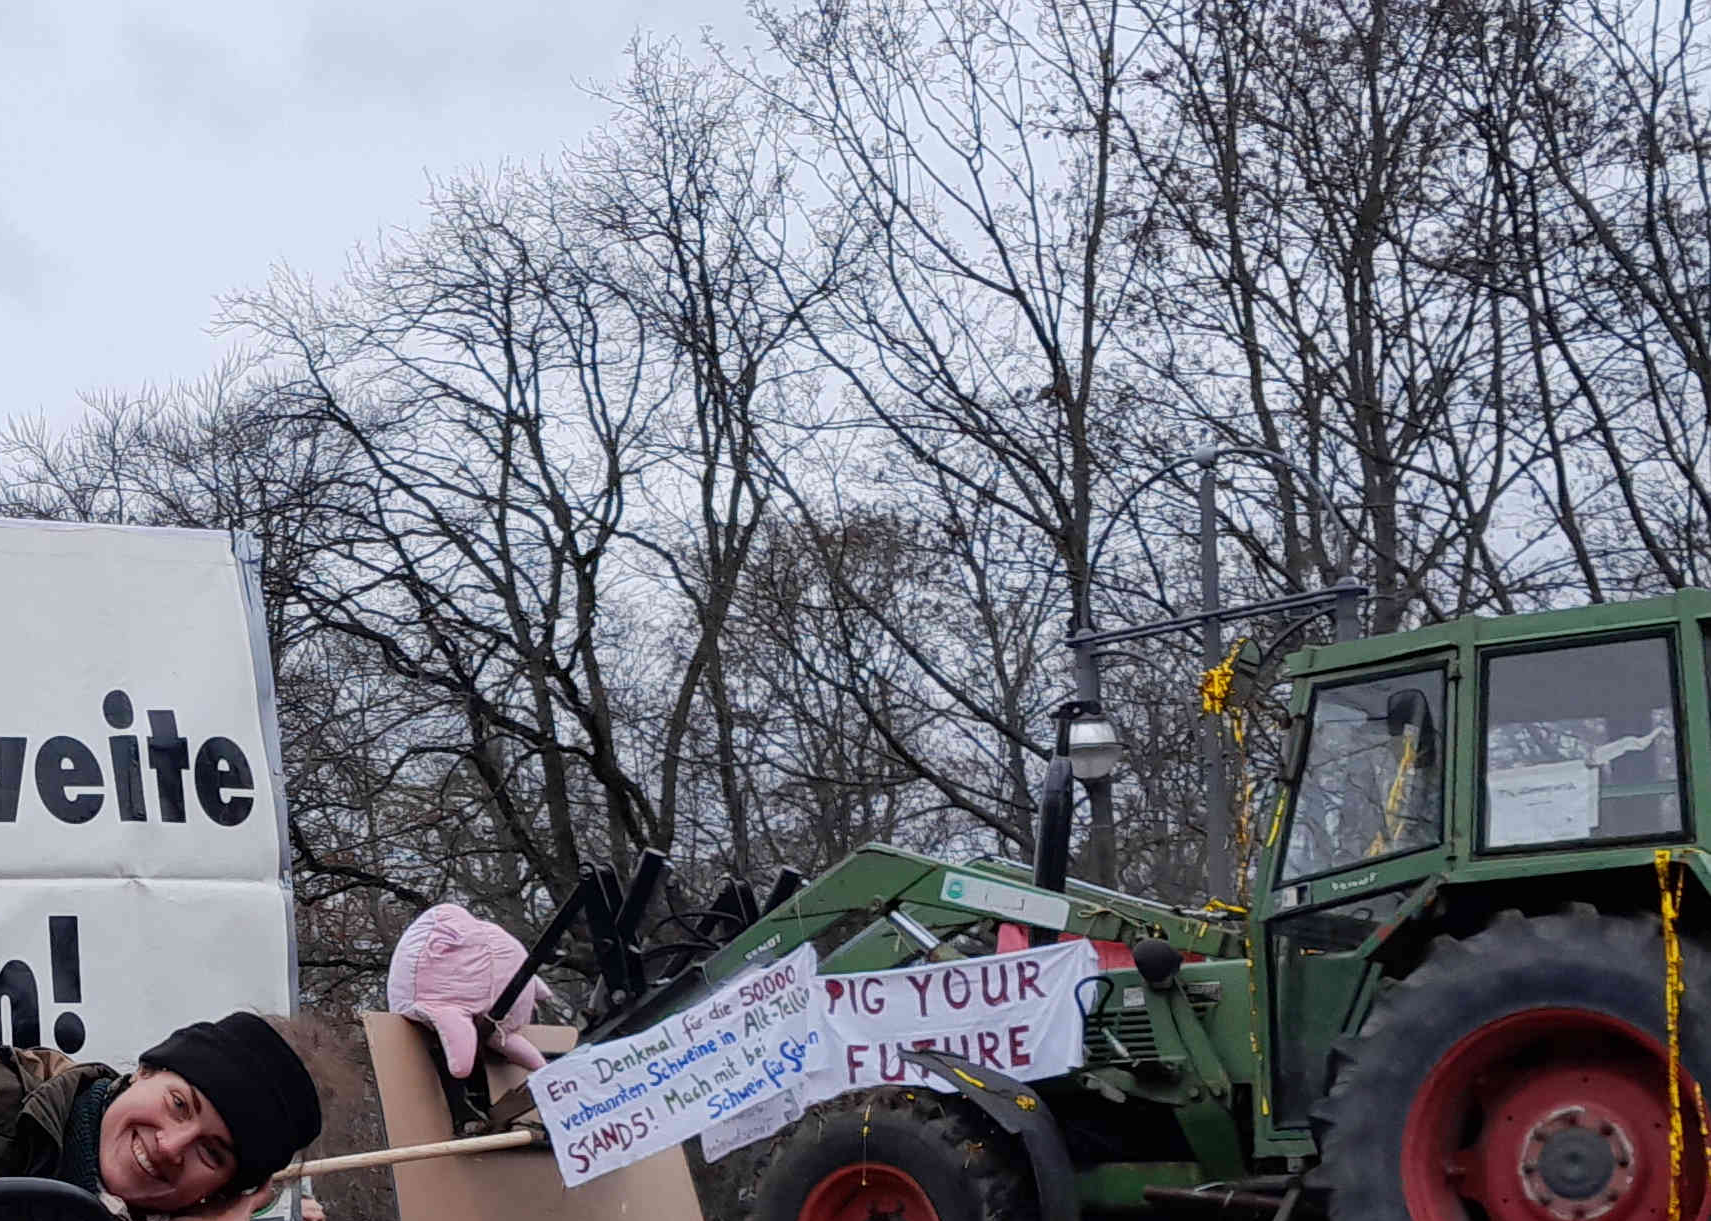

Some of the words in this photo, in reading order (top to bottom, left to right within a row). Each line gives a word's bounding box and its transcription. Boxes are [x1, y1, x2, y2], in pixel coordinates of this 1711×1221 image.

[824, 977, 886, 1016] PIG
[907, 960, 1048, 1018] YOUR
[546, 1079, 579, 1103] Ein
[591, 1025, 676, 1085] Denkmal
[708, 1001, 733, 1022] die
[738, 964, 796, 1007] 50.000
[846, 1025, 1032, 1085] FUTURE
[559, 1081, 649, 1132] verbrannten
[646, 1037, 719, 1087] Schweine
[716, 1029, 737, 1047] in
[663, 1072, 713, 1116] Mach
[713, 1056, 741, 1086] mit
[741, 1036, 767, 1068] bei
[762, 1057, 786, 1089] für
